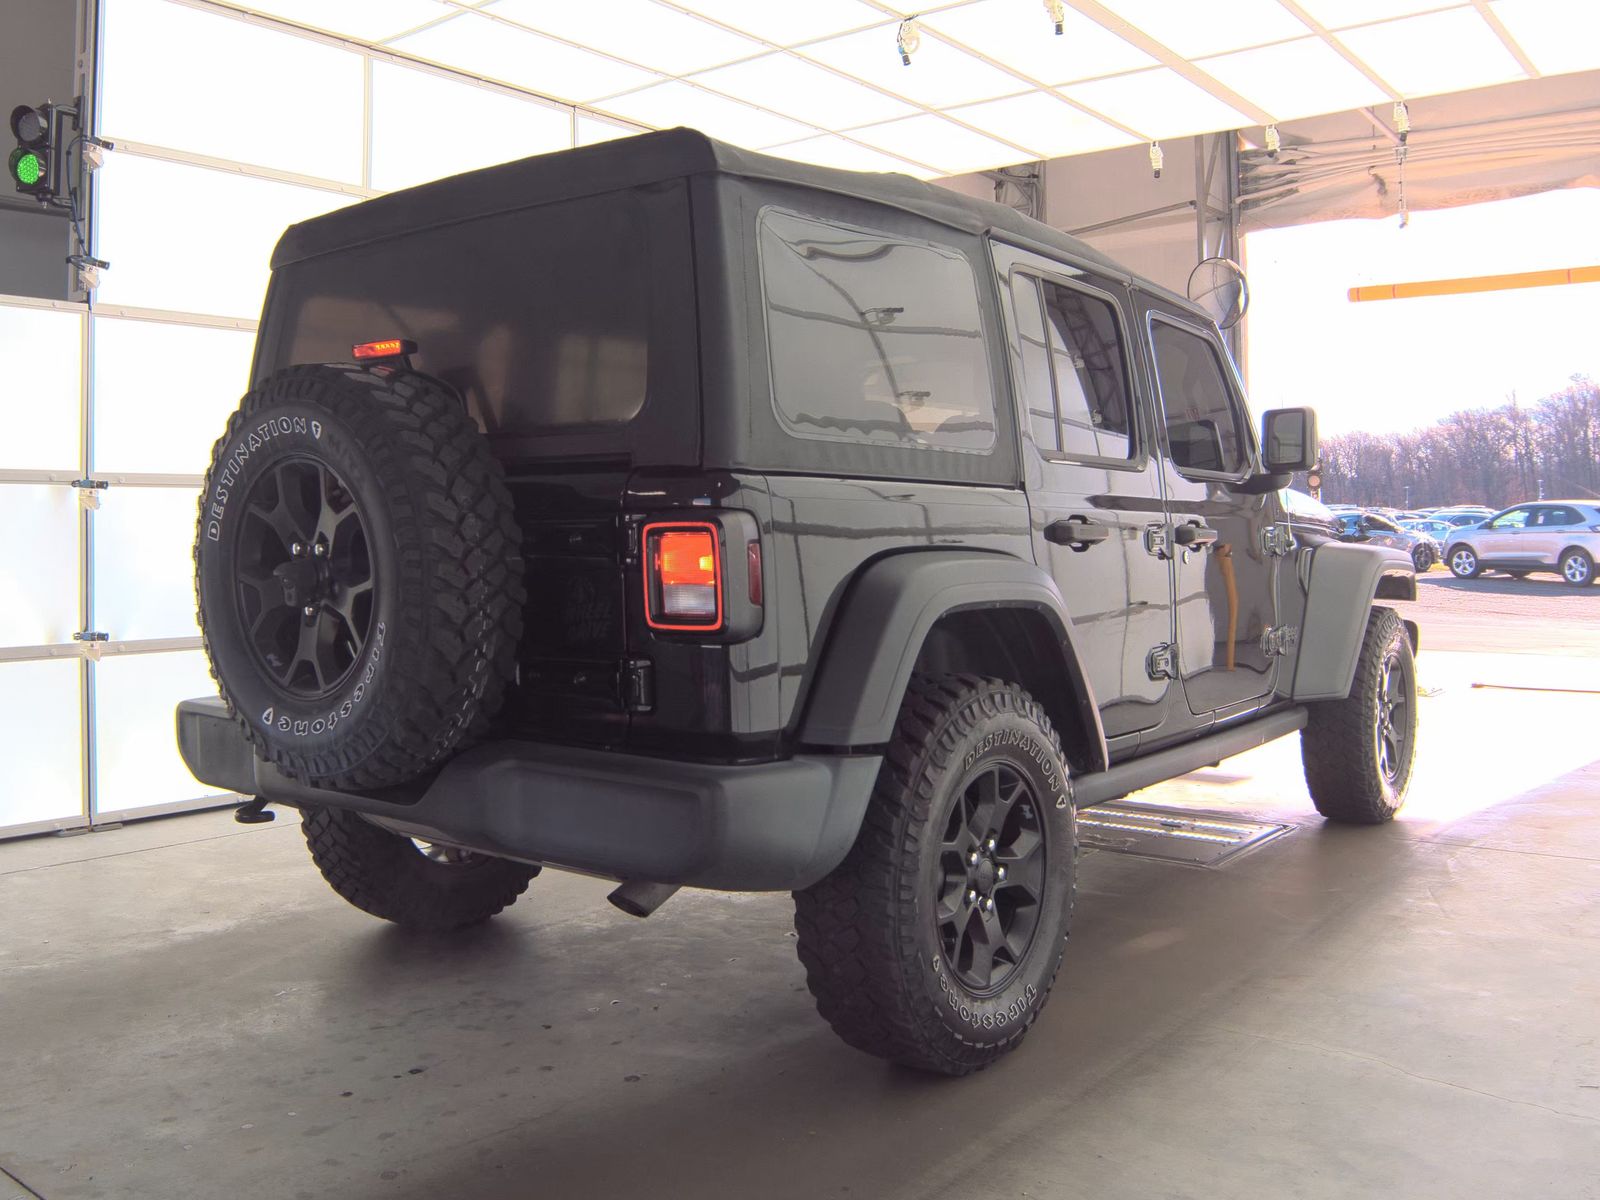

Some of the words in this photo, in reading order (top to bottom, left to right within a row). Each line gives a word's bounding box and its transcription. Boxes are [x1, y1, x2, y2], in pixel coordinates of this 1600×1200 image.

[207, 416, 307, 541] DESTINATION
[278, 622, 386, 736] Firestone
[964, 728, 1060, 792] DESTINATION
[940, 973, 1037, 1030] Firestone
